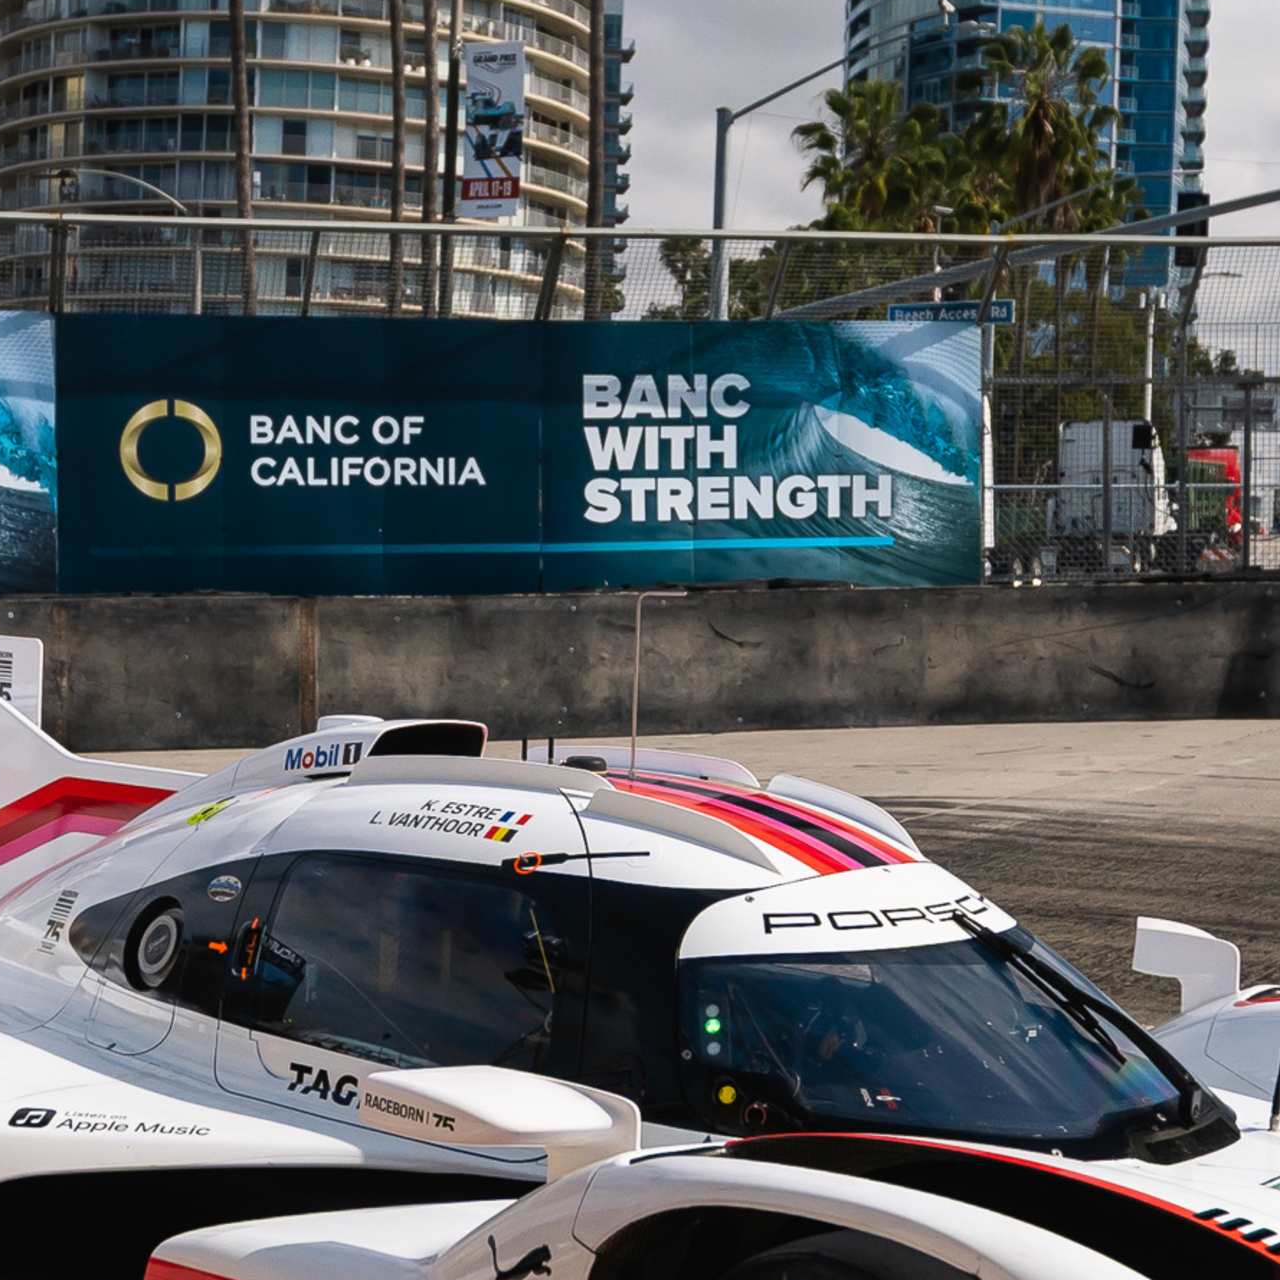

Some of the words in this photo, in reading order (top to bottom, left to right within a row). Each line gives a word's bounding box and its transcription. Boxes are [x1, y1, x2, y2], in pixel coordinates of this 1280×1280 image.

[939, 308, 978, 320] Acces
[582, 373, 752, 419] BANC
[249, 415, 360, 445] BANC
[371, 415, 424, 445] OF
[583, 424, 738, 471] WITH
[249, 456, 487, 487] CALIFORNIA
[581, 473, 893, 524] STRENGTH
[285, 744, 340, 770] Mobil
[369, 811, 382, 825] L.
[388, 812, 485, 838] VANTHOOR
[421, 800, 436, 812] K.
[440, 801, 502, 821] ESTRE
[287, 1061, 359, 1107] TAG
[364, 1093, 424, 1124] RACEBORN
[432, 1113, 456, 1132] 75
[56, 1118, 129, 1133] Apple
[134, 1122, 211, 1136] Music
